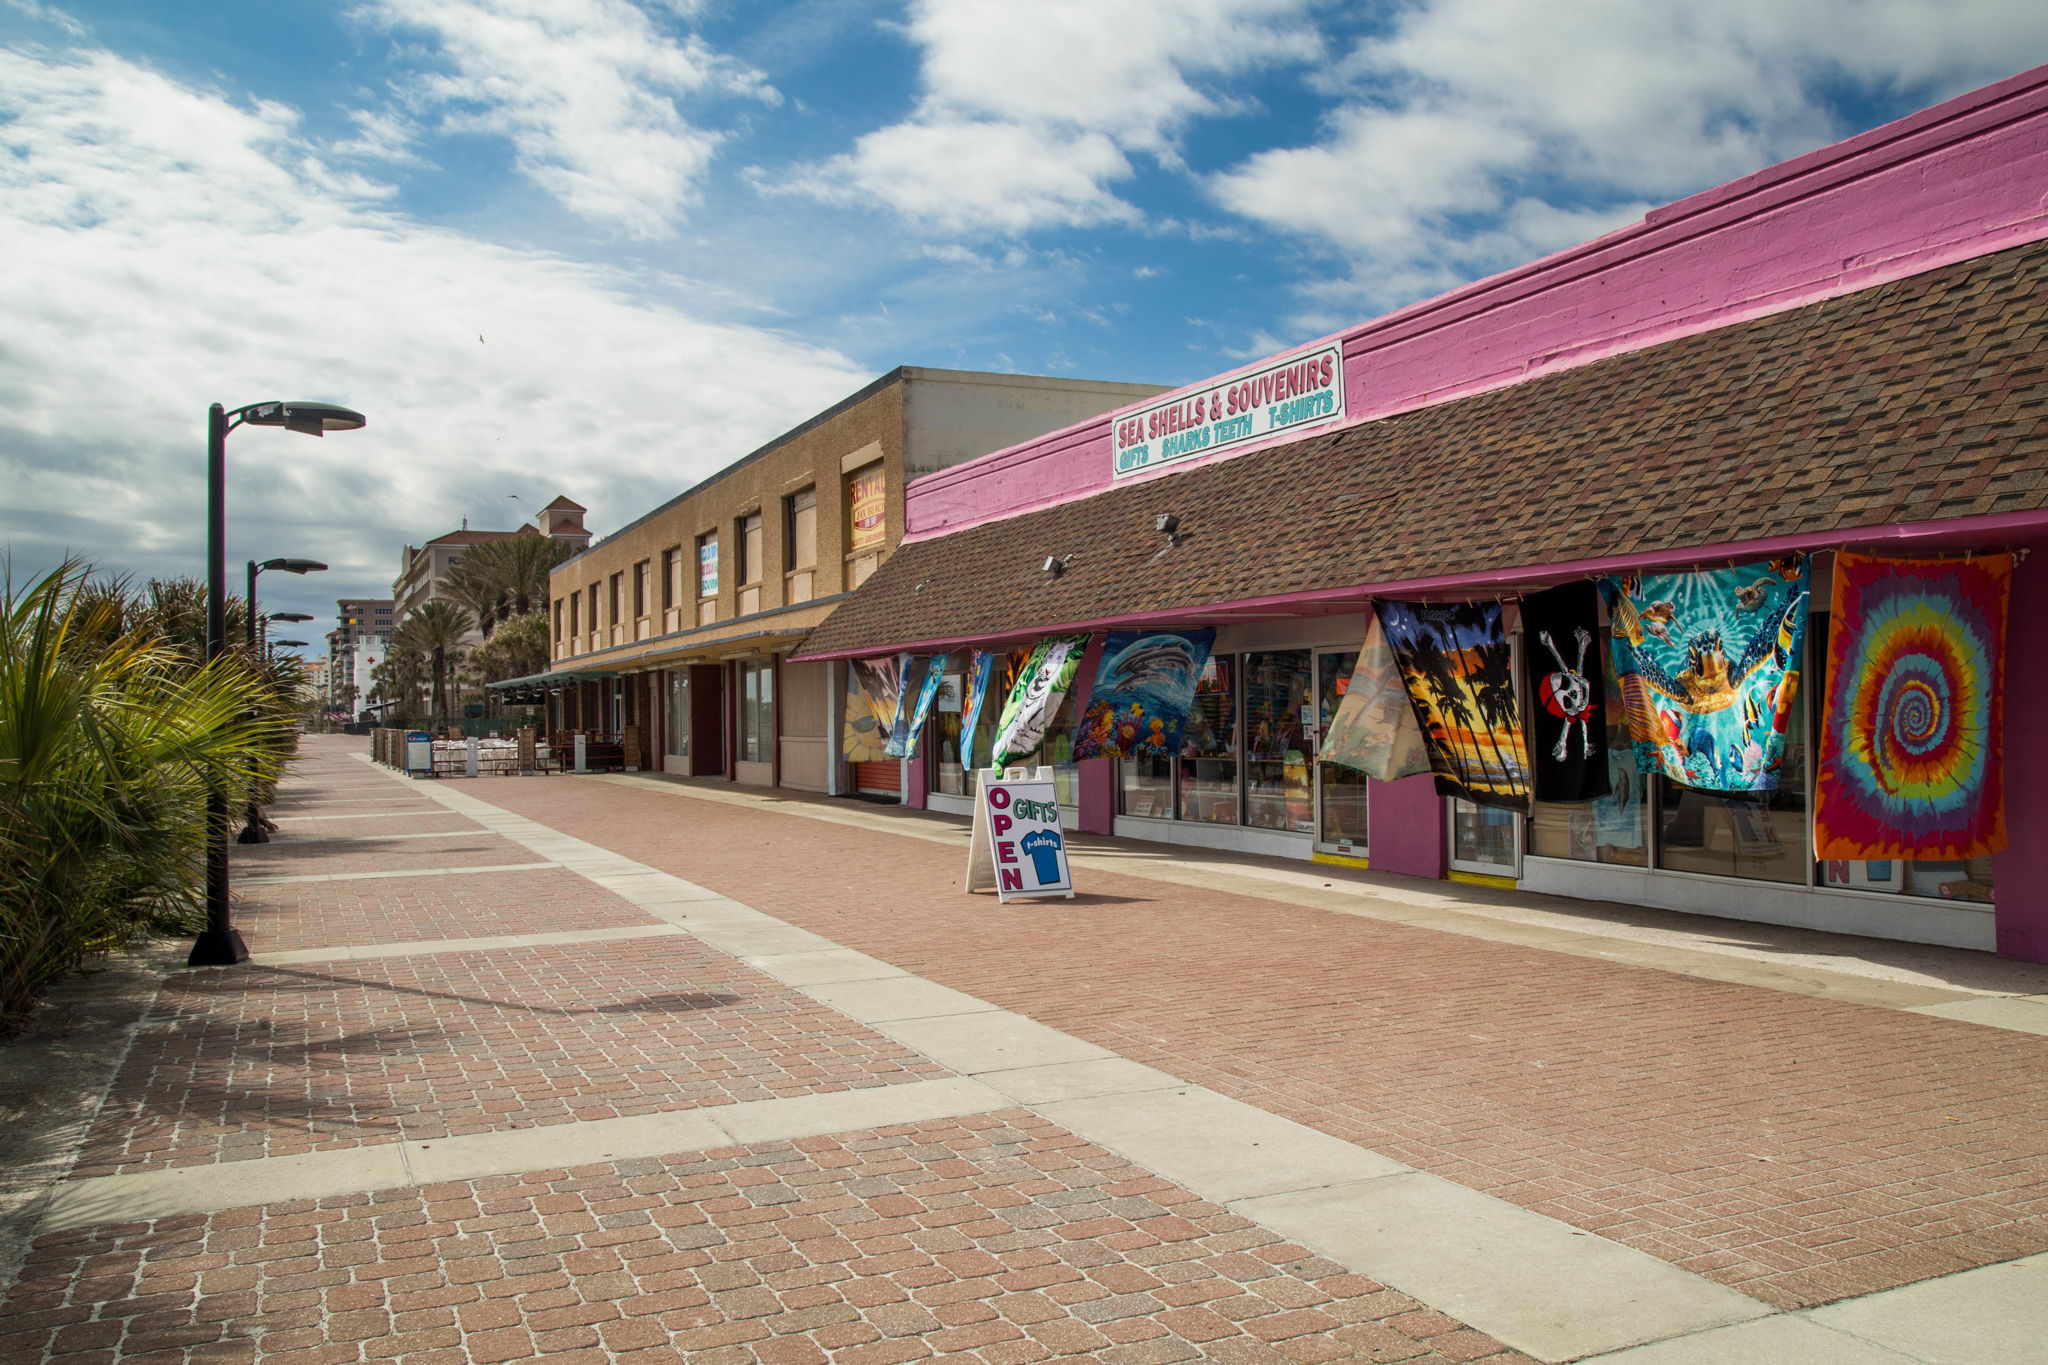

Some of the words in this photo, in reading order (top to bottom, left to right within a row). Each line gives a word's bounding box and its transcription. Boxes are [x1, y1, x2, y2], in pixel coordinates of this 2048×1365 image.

[1119, 416, 1144, 449] SEA
[1149, 397, 1205, 439] SHELLS
[1210, 391, 1223, 421] &
[1227, 355, 1333, 415] SOUVENIRS
[1119, 444, 1149, 470] GIFTS
[1162, 425, 1211, 459] SHARKS
[1213, 413, 1252, 444] TEETH
[1269, 389, 1334, 429] T-SHIRTS
[1196, 664, 1228, 693] PEN
[1012, 798, 1058, 823] GIFTS
[989, 787, 1024, 891] OPEN
[1026, 837, 1058, 850] t-shirts
